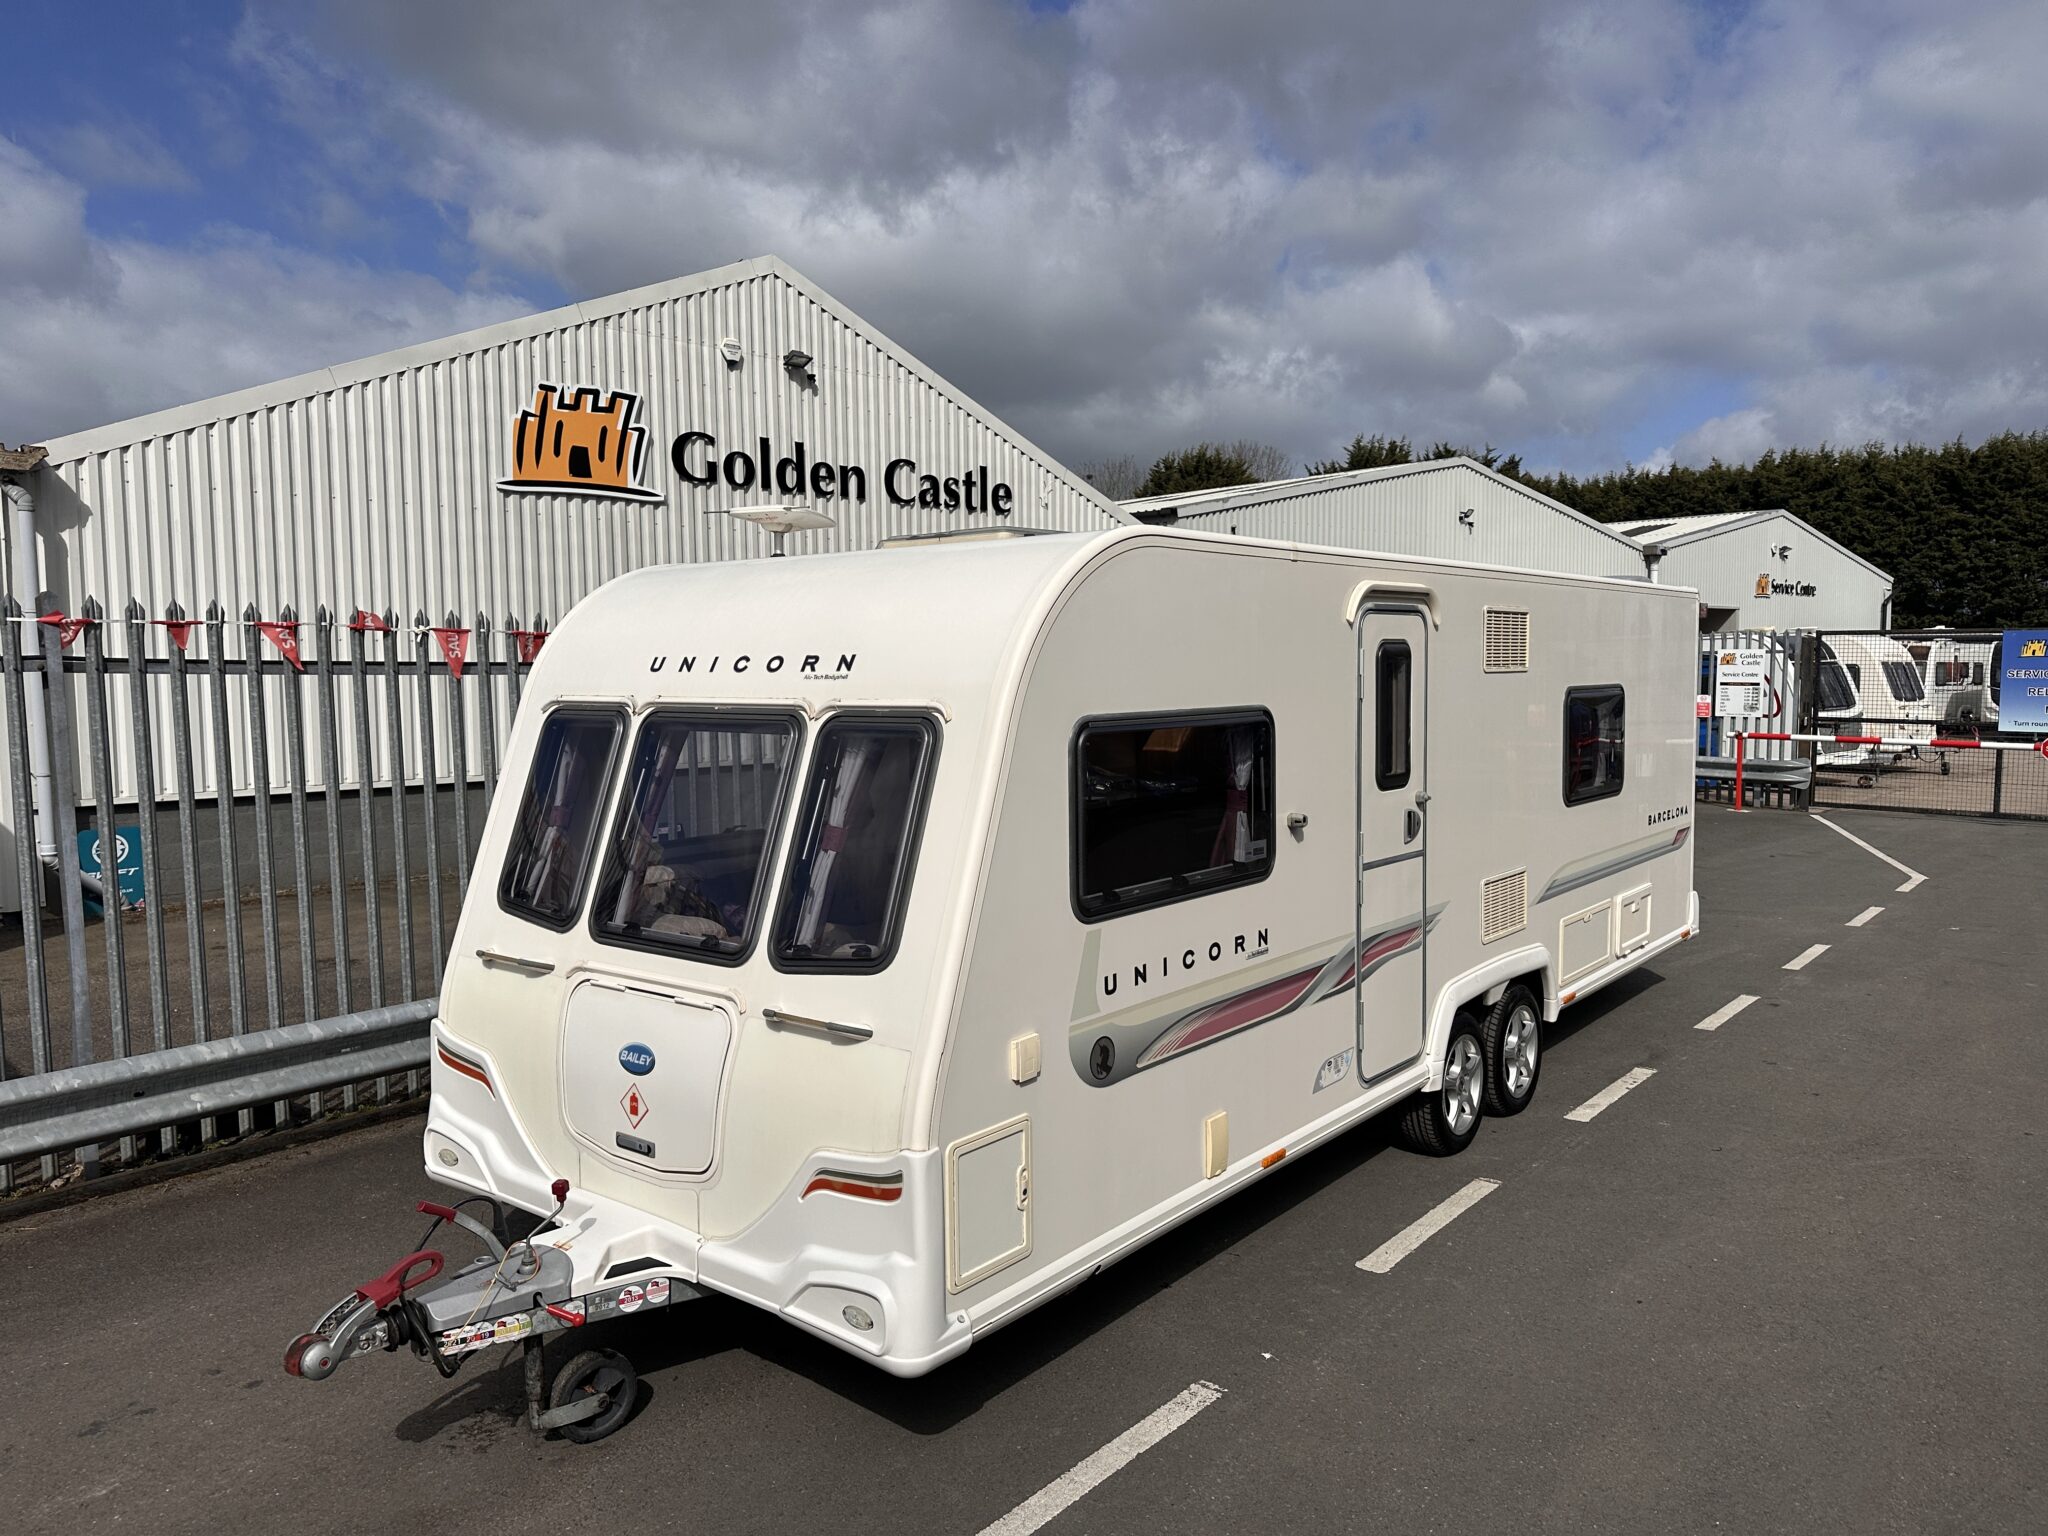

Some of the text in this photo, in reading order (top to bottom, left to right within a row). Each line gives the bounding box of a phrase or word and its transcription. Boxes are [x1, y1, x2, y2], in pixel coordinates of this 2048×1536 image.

[671, 431, 1012, 515] Golden Castle
[1771, 579, 1816, 597] Service Centre
[650, 653, 857, 673] UNICORN
[1648, 805, 1688, 826] BARCELONA
[1104, 928, 1268, 996] UNICORN
[620, 1050, 653, 1066] BAILEY
[624, 1295, 639, 1304] 2013
